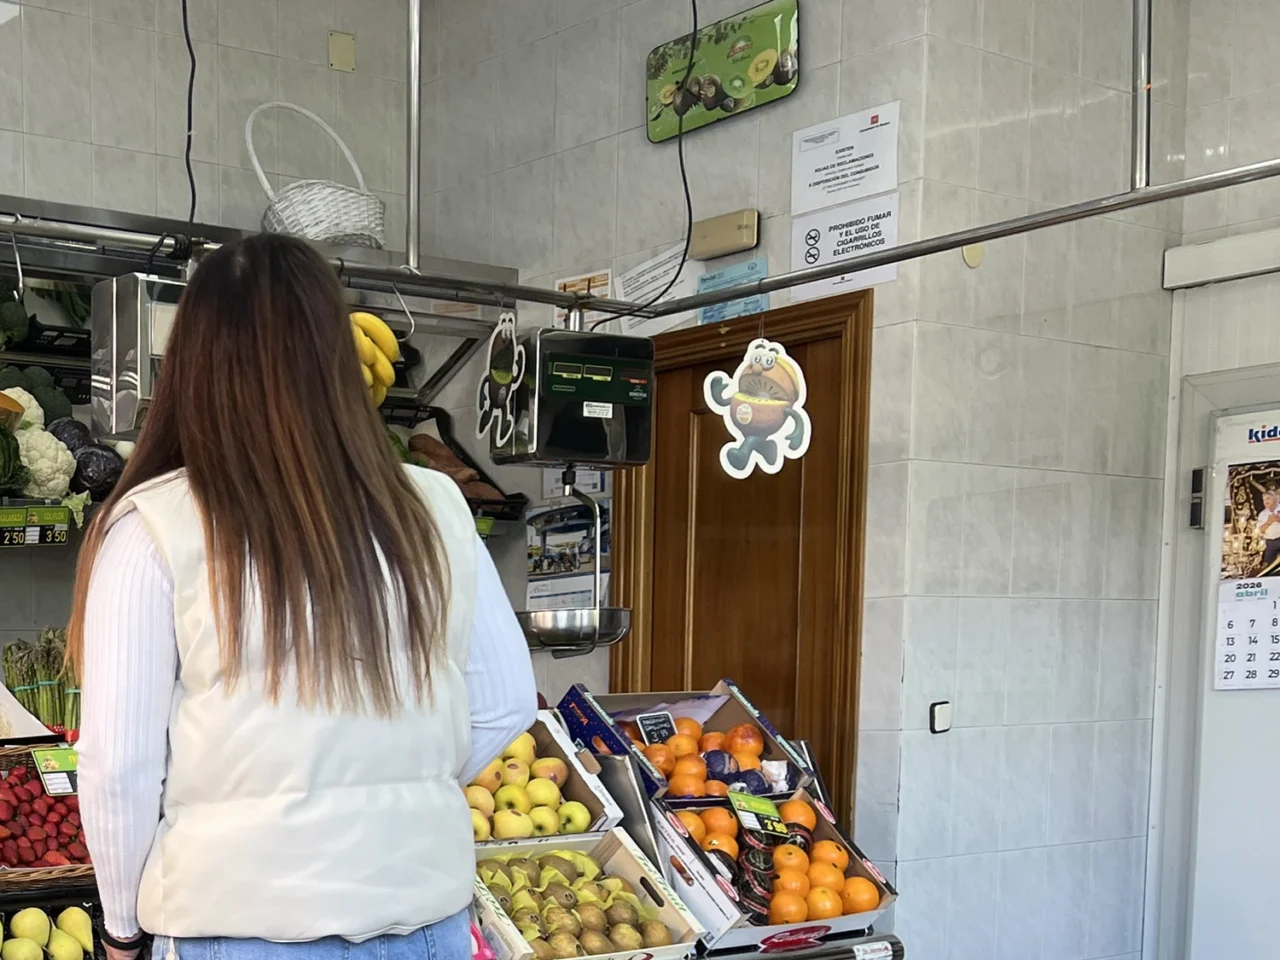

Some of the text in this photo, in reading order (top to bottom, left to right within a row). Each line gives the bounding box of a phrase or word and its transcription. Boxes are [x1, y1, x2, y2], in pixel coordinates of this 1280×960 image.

[828, 211, 892, 232] PROHIBIDO FUMAR
[855, 225, 869, 234] USO
[871, 222, 880, 230] DE
[837, 230, 882, 247] CIGARRILLOS
[833, 238, 885, 256] ELECTRÓNICOS
[1248, 424, 1280, 443] kid
[3, 532, 25, 544] 2'50
[46, 530, 67, 542] 3'50
[1236, 582, 1262, 590] 2026
[1235, 588, 1268, 598] abril
[1273, 600, 1277, 610] 1
[1227, 617, 1278, 630] 6 7 8
[1226, 634, 1280, 646] 13 14 15
[1224, 652, 1280, 663] 20 21 22
[1223, 669, 1280, 680] 27 28 29
